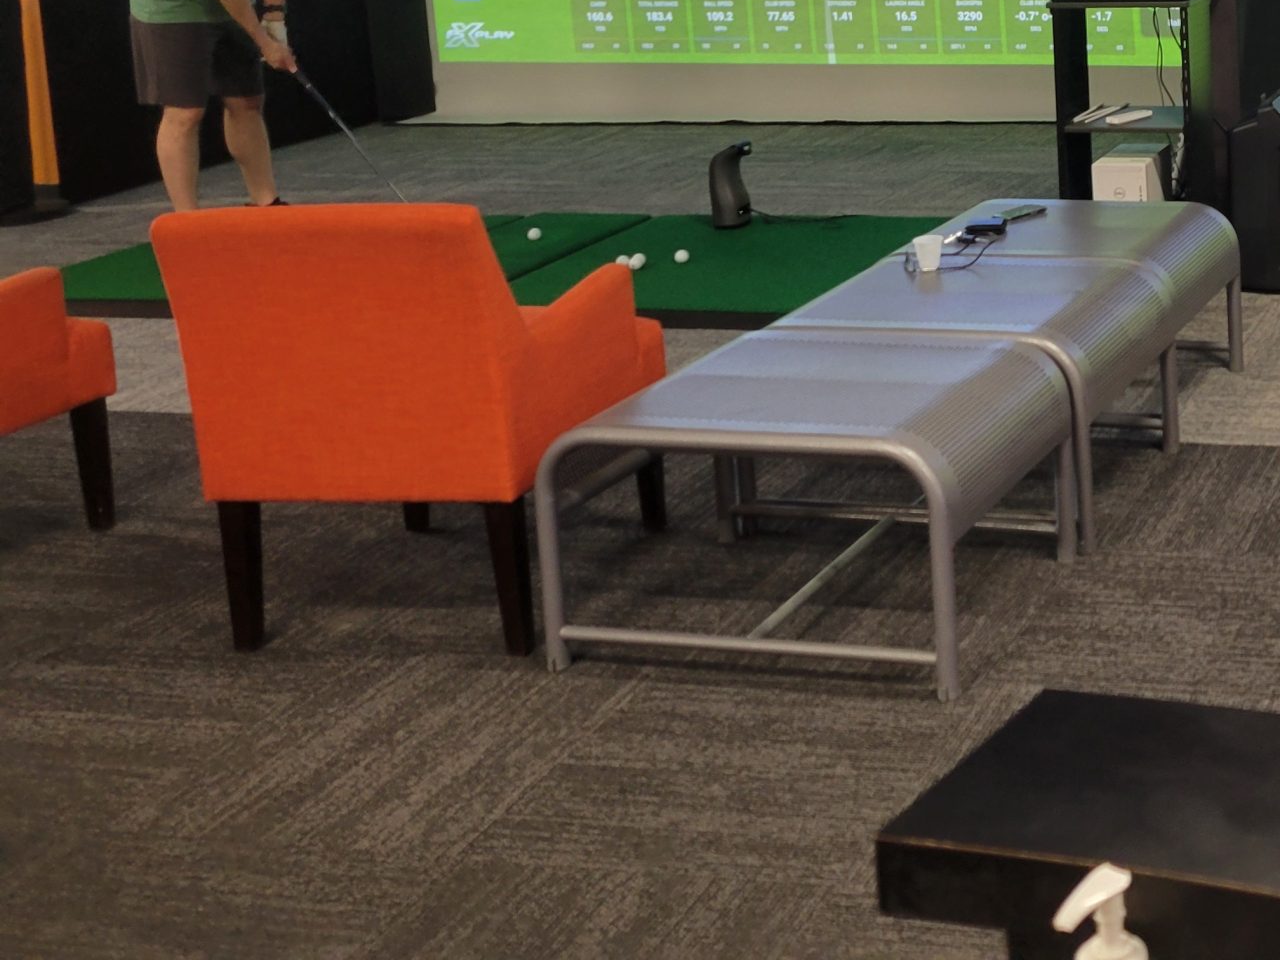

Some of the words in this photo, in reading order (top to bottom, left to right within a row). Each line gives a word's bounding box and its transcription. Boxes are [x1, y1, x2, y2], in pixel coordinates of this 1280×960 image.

[832, 11, 853, 22] 1.41
[895, 11, 917, 22] 16.5
[957, 11, 983, 21] 3290
[1091, 11, 1112, 22] -1.7
